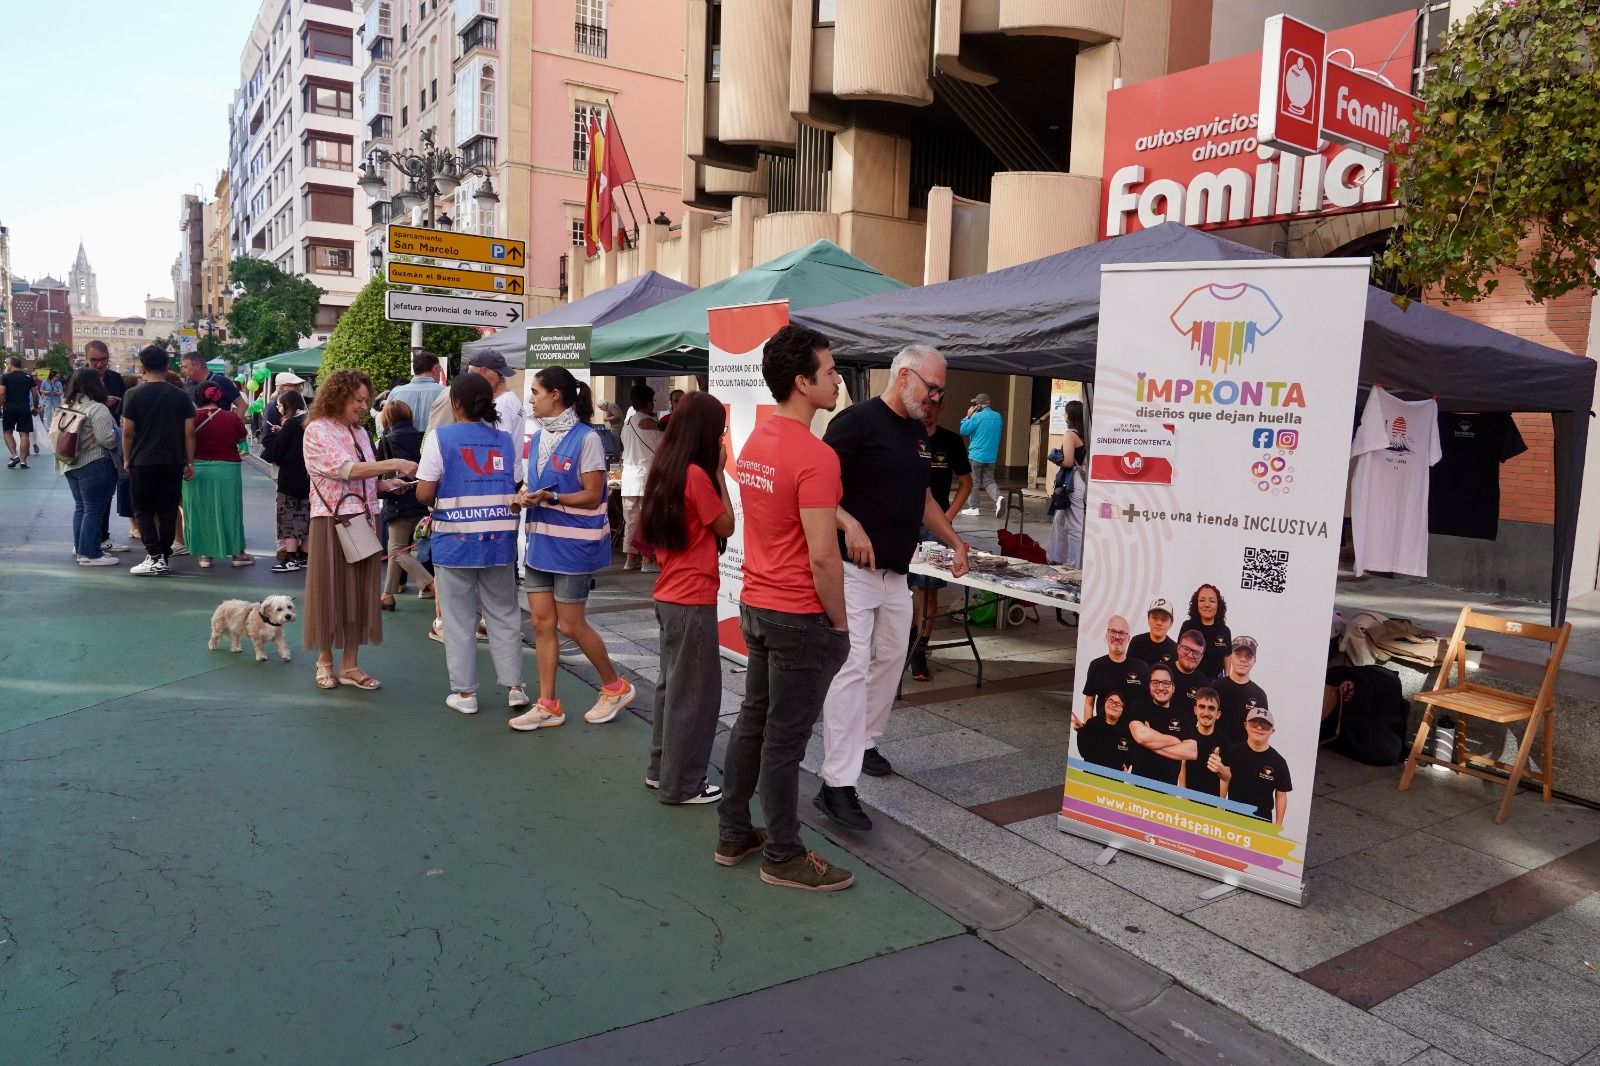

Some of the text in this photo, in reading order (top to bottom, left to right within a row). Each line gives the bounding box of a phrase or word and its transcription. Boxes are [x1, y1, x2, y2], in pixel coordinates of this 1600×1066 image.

[1135, 113, 1259, 151] autoservicios
[1192, 137, 1258, 162] ahorro
[394, 232, 442, 242] aparcamiento
[394, 240, 460, 256] San Marcelo
[493, 245, 504, 257] P
[392, 269, 423, 279] Guzmán
[436, 274, 461, 283] Bueno
[393, 302, 422, 311] jefatura
[425, 305, 460, 314] provincial
[530, 342, 586, 352] ACCIÓN VOLUNTARIA
[540, 352, 580, 360] COOPERACIÓN
[709, 364, 764, 373] PLATAFORMA DE ENT
[715, 379, 758, 387] VOLUNTARIADO
[758, 379, 765, 387] DE
[1135, 406, 1303, 425] diseños que dejan huella
[1133, 438, 1172, 447] CONTENTA
[761, 464, 775, 477] con
[1170, 511, 1192, 523] una
[1196, 511, 1239, 528] tienda
[1243, 514, 1328, 539] INCLUSIVA
[1096, 794, 1252, 848] www.improntaspain.org
